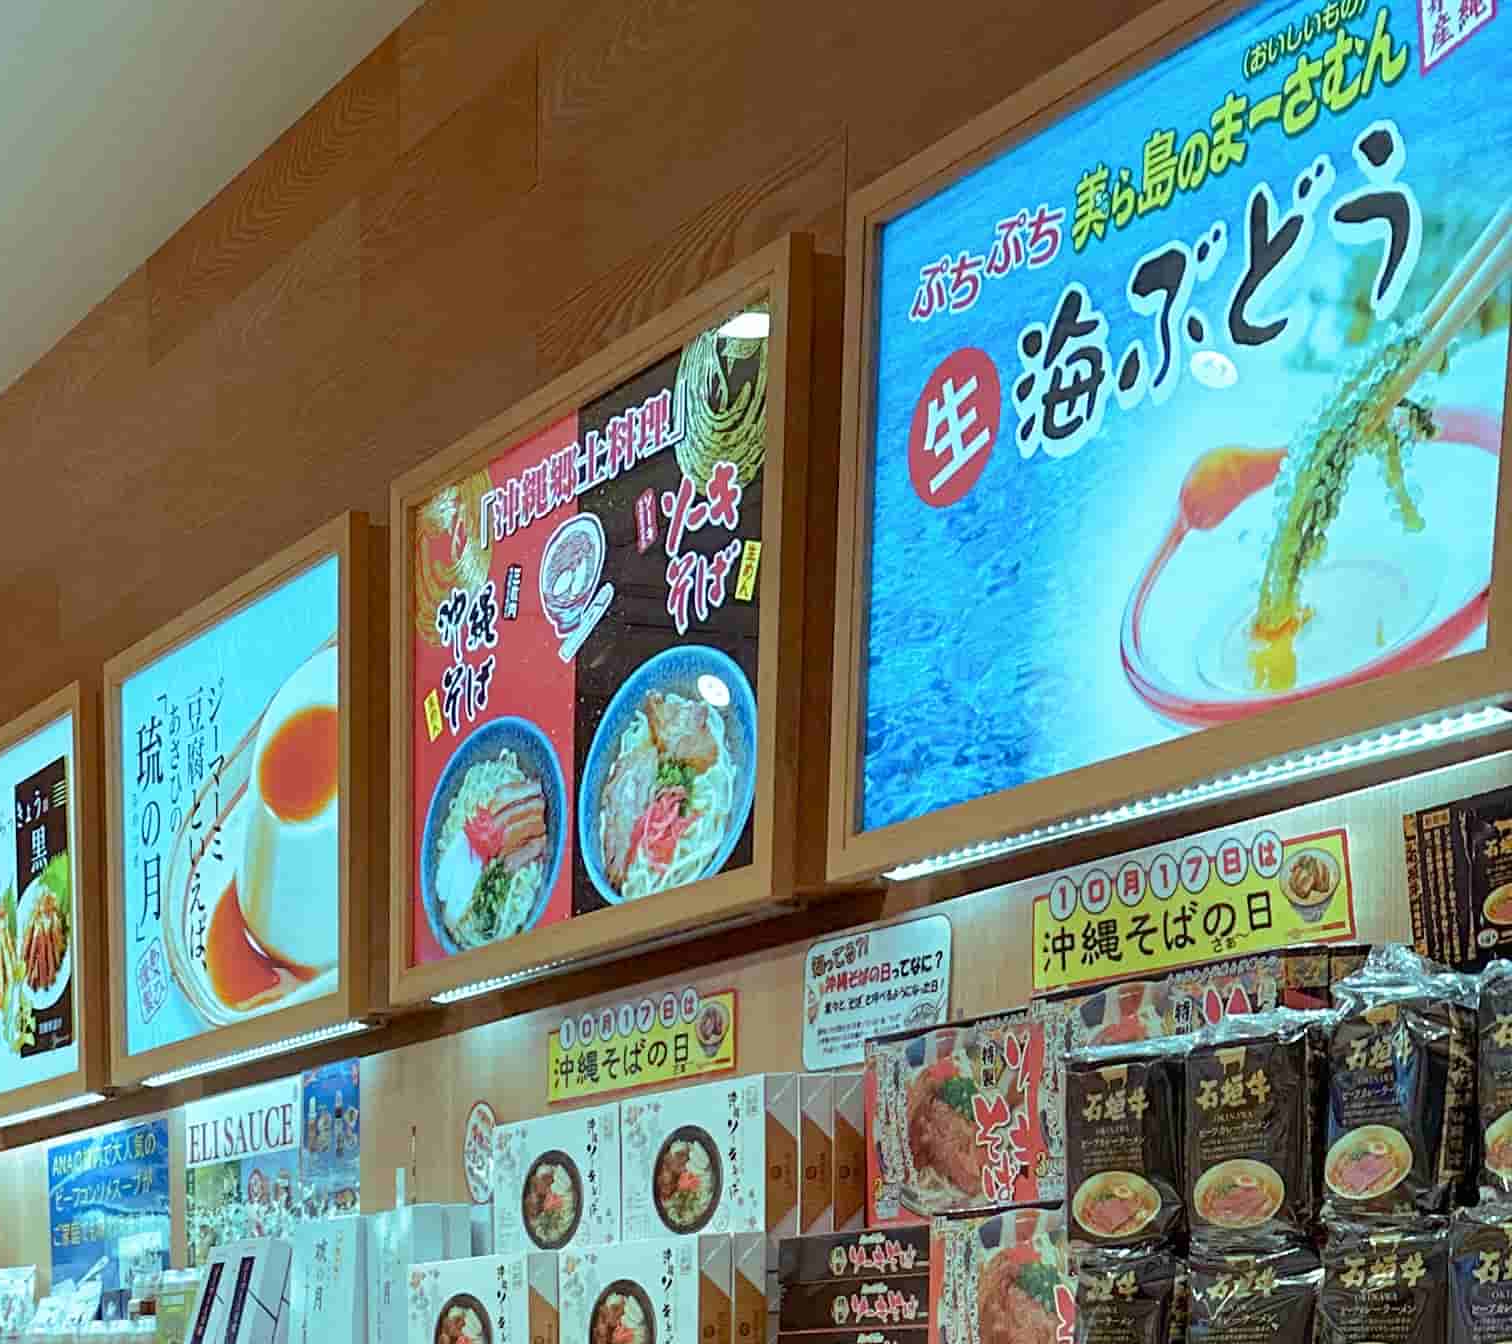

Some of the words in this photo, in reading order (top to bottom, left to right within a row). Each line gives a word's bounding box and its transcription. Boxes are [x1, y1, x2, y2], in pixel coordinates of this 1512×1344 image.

[1072, 8, 1408, 252] 美ら島のまーさむん
[911, 205, 1065, 321] ぷちぷち
[1016, 130, 1410, 441] 海ぶどう
[922, 374, 991, 496] 生
[662, 462, 742, 553] ソーキ
[438, 583, 498, 658] 沖縄
[667, 539, 741, 635] そば
[442, 656, 494, 735] そば
[209, 677, 225, 861] ジーマーミ
[30, 825, 49, 875] 黒
[1043, 890, 1273, 972] 沖縄そばの日
[553, 1033, 689, 1088] 沖縄そばの日
[1196, 1069, 1271, 1109] 石垣牛
[189, 1120, 217, 1164] ELI
[223, 1103, 294, 1156] SAUCE
[1083, 1087, 1150, 1122] 石垣牛
